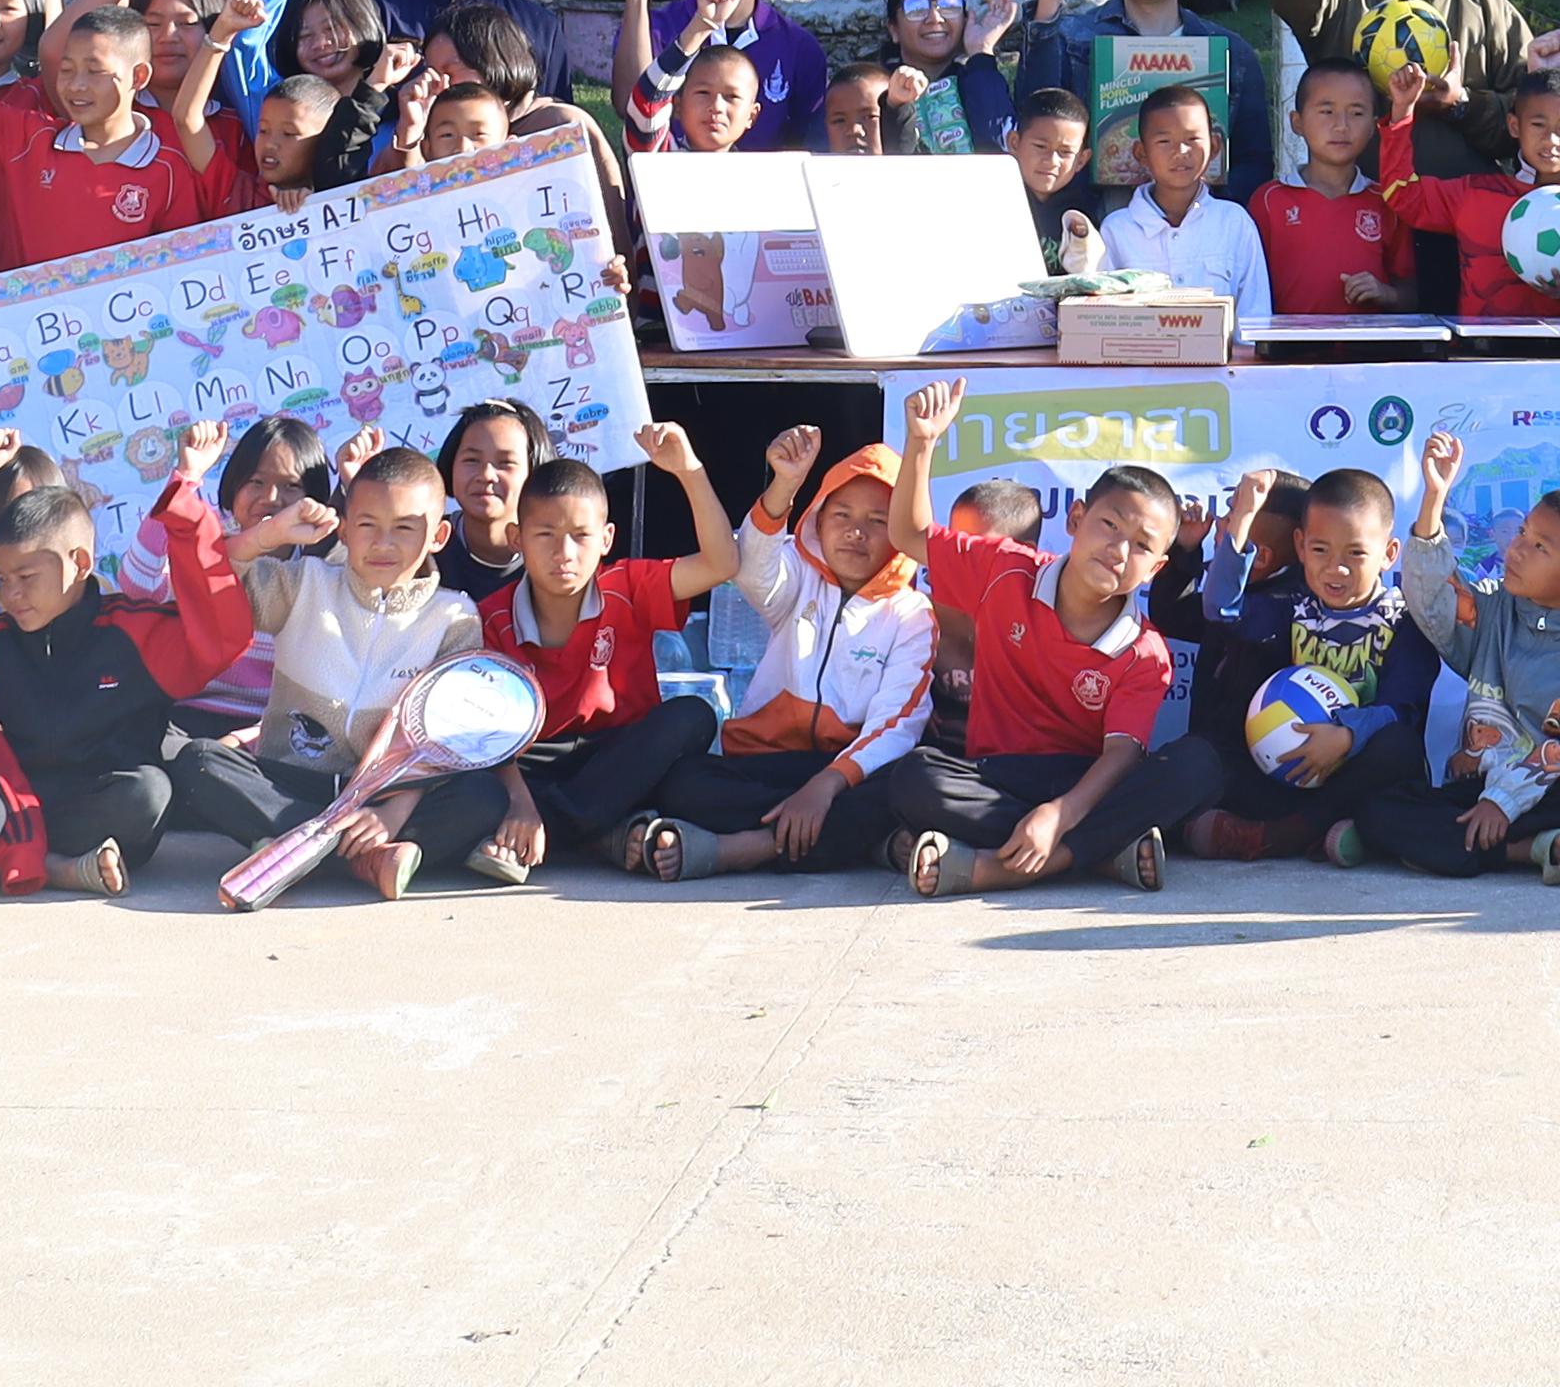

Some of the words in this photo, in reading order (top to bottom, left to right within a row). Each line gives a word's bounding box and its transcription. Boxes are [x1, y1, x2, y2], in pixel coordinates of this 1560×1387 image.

[1129, 52, 1193, 72] MAMA
[1099, 76, 1141, 93] MINCED
[1099, 88, 1130, 101] PORK
[1099, 92, 1149, 110] FLAVOUR
[237, 215, 312, 252] อักษร
[321, 196, 364, 229] A-Z
[457, 202, 502, 239] Hh
[386, 222, 433, 255] Gg
[484, 230, 518, 249] hippo
[318, 245, 356, 278] Ff
[180, 275, 227, 310] Dd
[245, 261, 292, 296] Ee
[108, 290, 155, 323] Cc
[484, 296, 531, 328] Qq
[1158, 314, 1203, 329] MAMA
[36, 311, 84, 345] Bb
[150, 318, 171, 330] cat
[413, 319, 460, 351] Pp
[342, 335, 391, 365] Oo
[9, 362, 30, 375] ant
[265, 360, 311, 396] Nn
[195, 376, 248, 412] Mm
[548, 377, 592, 411] Zz
[57, 409, 103, 445] Kk
[940, 406, 1221, 462] ายอาสา
